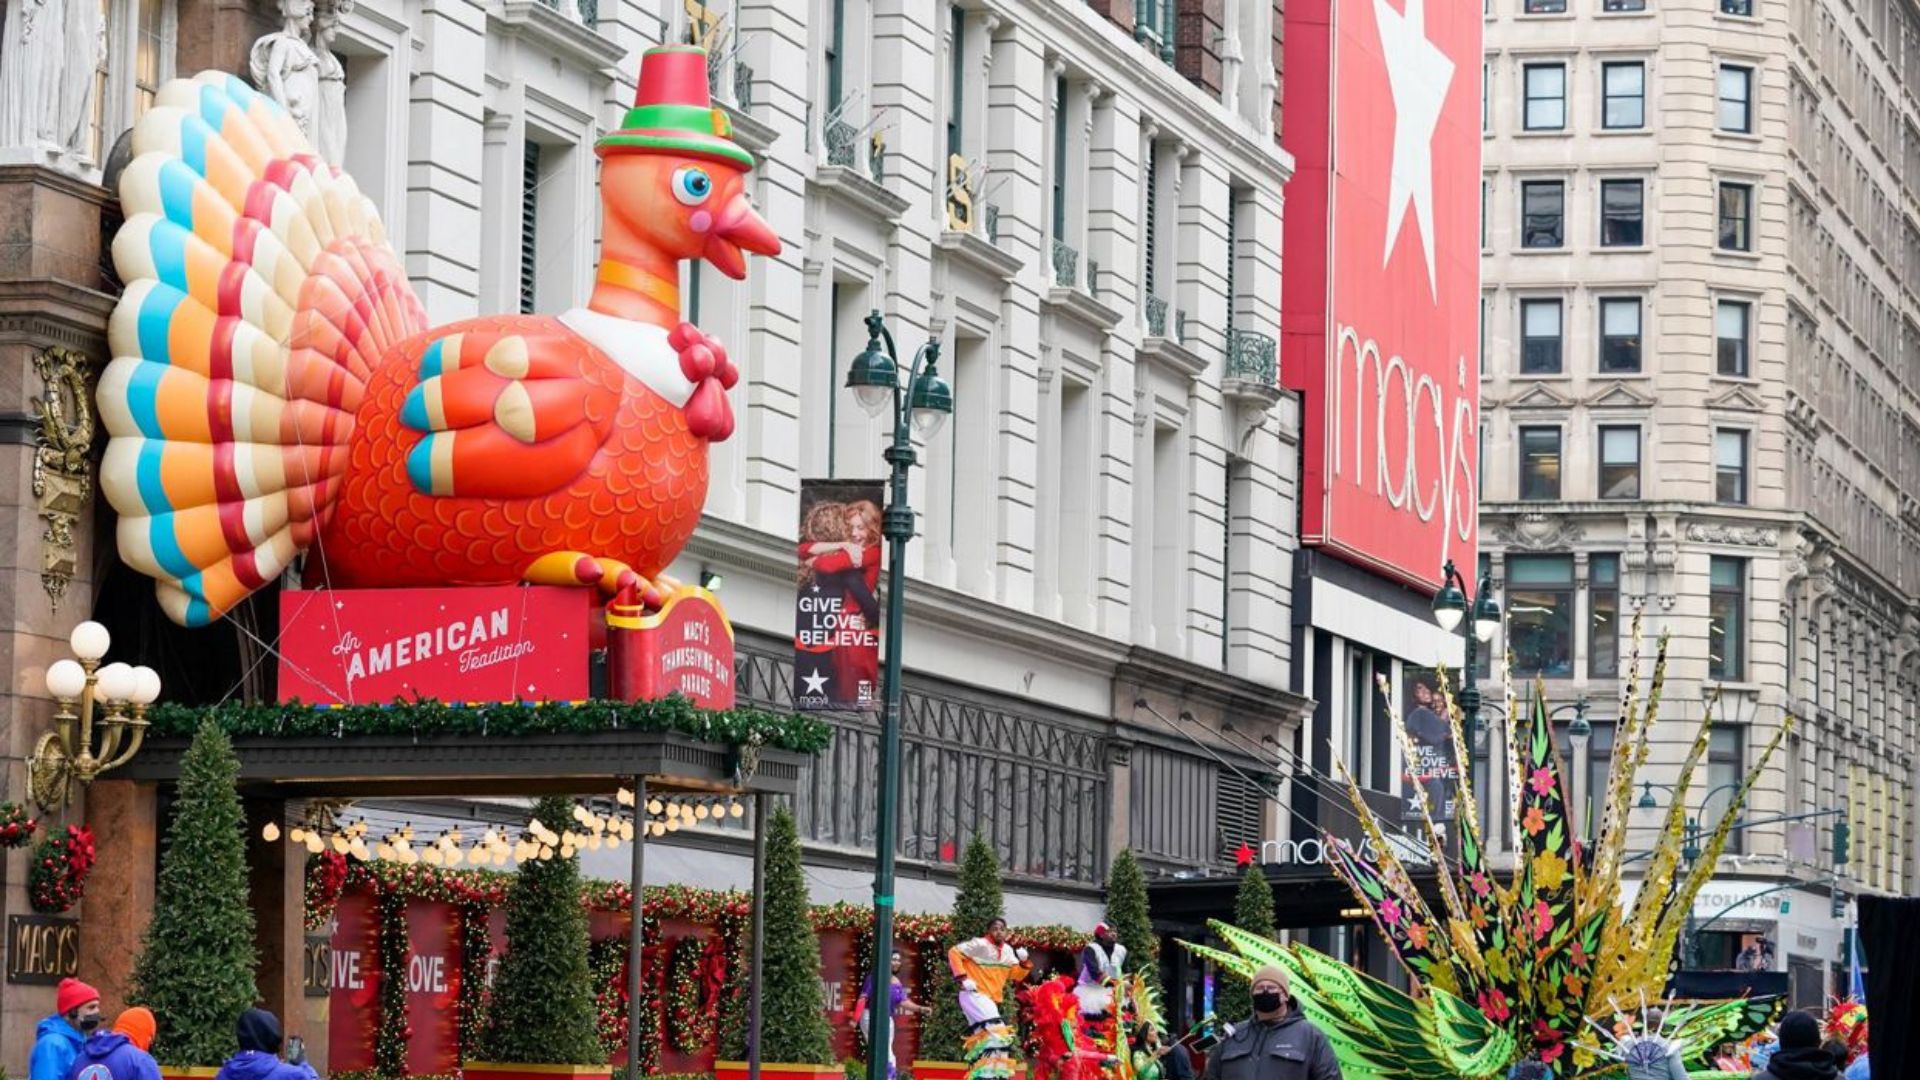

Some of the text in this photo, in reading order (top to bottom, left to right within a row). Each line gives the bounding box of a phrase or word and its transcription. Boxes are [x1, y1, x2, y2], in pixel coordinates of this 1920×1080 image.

[799, 596, 846, 613] GIVE.
[812, 613, 866, 630] LOVE.
[332, 631, 361, 655] An
[346, 607, 509, 682] AMERICAN
[799, 629, 878, 646] BELIEVE.
[459, 639, 535, 673] Tradition
[662, 647, 729, 687] THANKSGIVING DAY
[681, 673, 711, 699] PARADE
[331, 950, 365, 989] IVE.
[407, 955, 448, 992] OVE.
